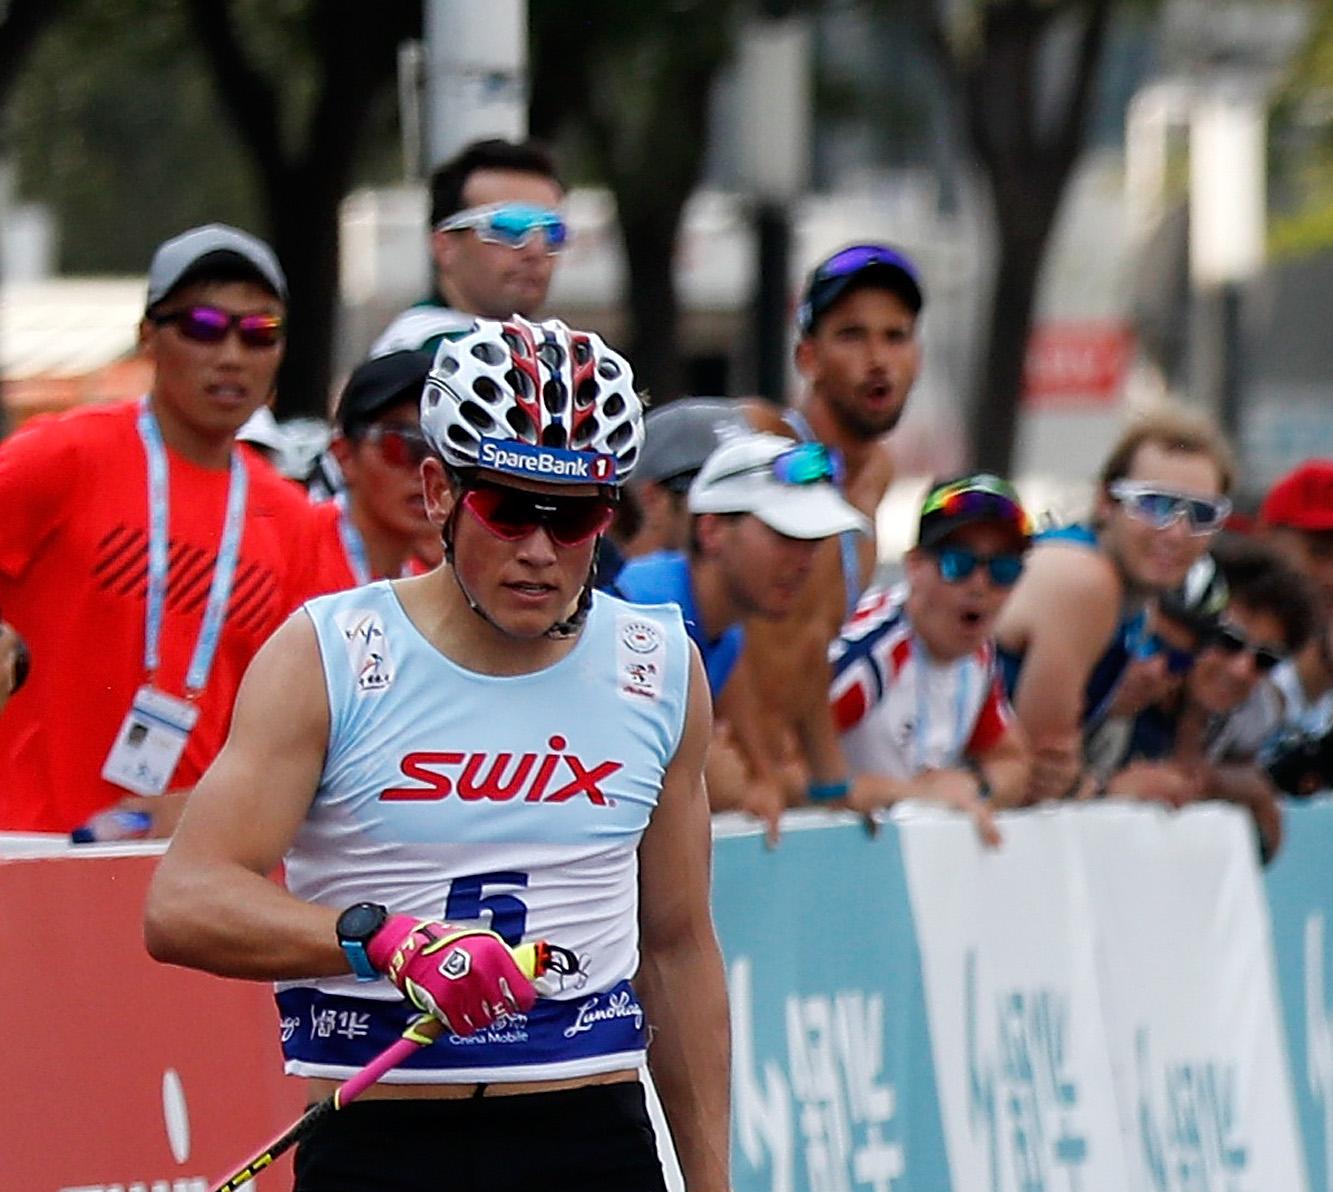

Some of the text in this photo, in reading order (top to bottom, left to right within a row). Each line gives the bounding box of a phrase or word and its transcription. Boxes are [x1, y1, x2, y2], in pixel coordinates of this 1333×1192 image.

[483, 443, 607, 477] SpareBank 1
[444, 871, 530, 946] 5
[487, 1028, 530, 1045] Mobile
